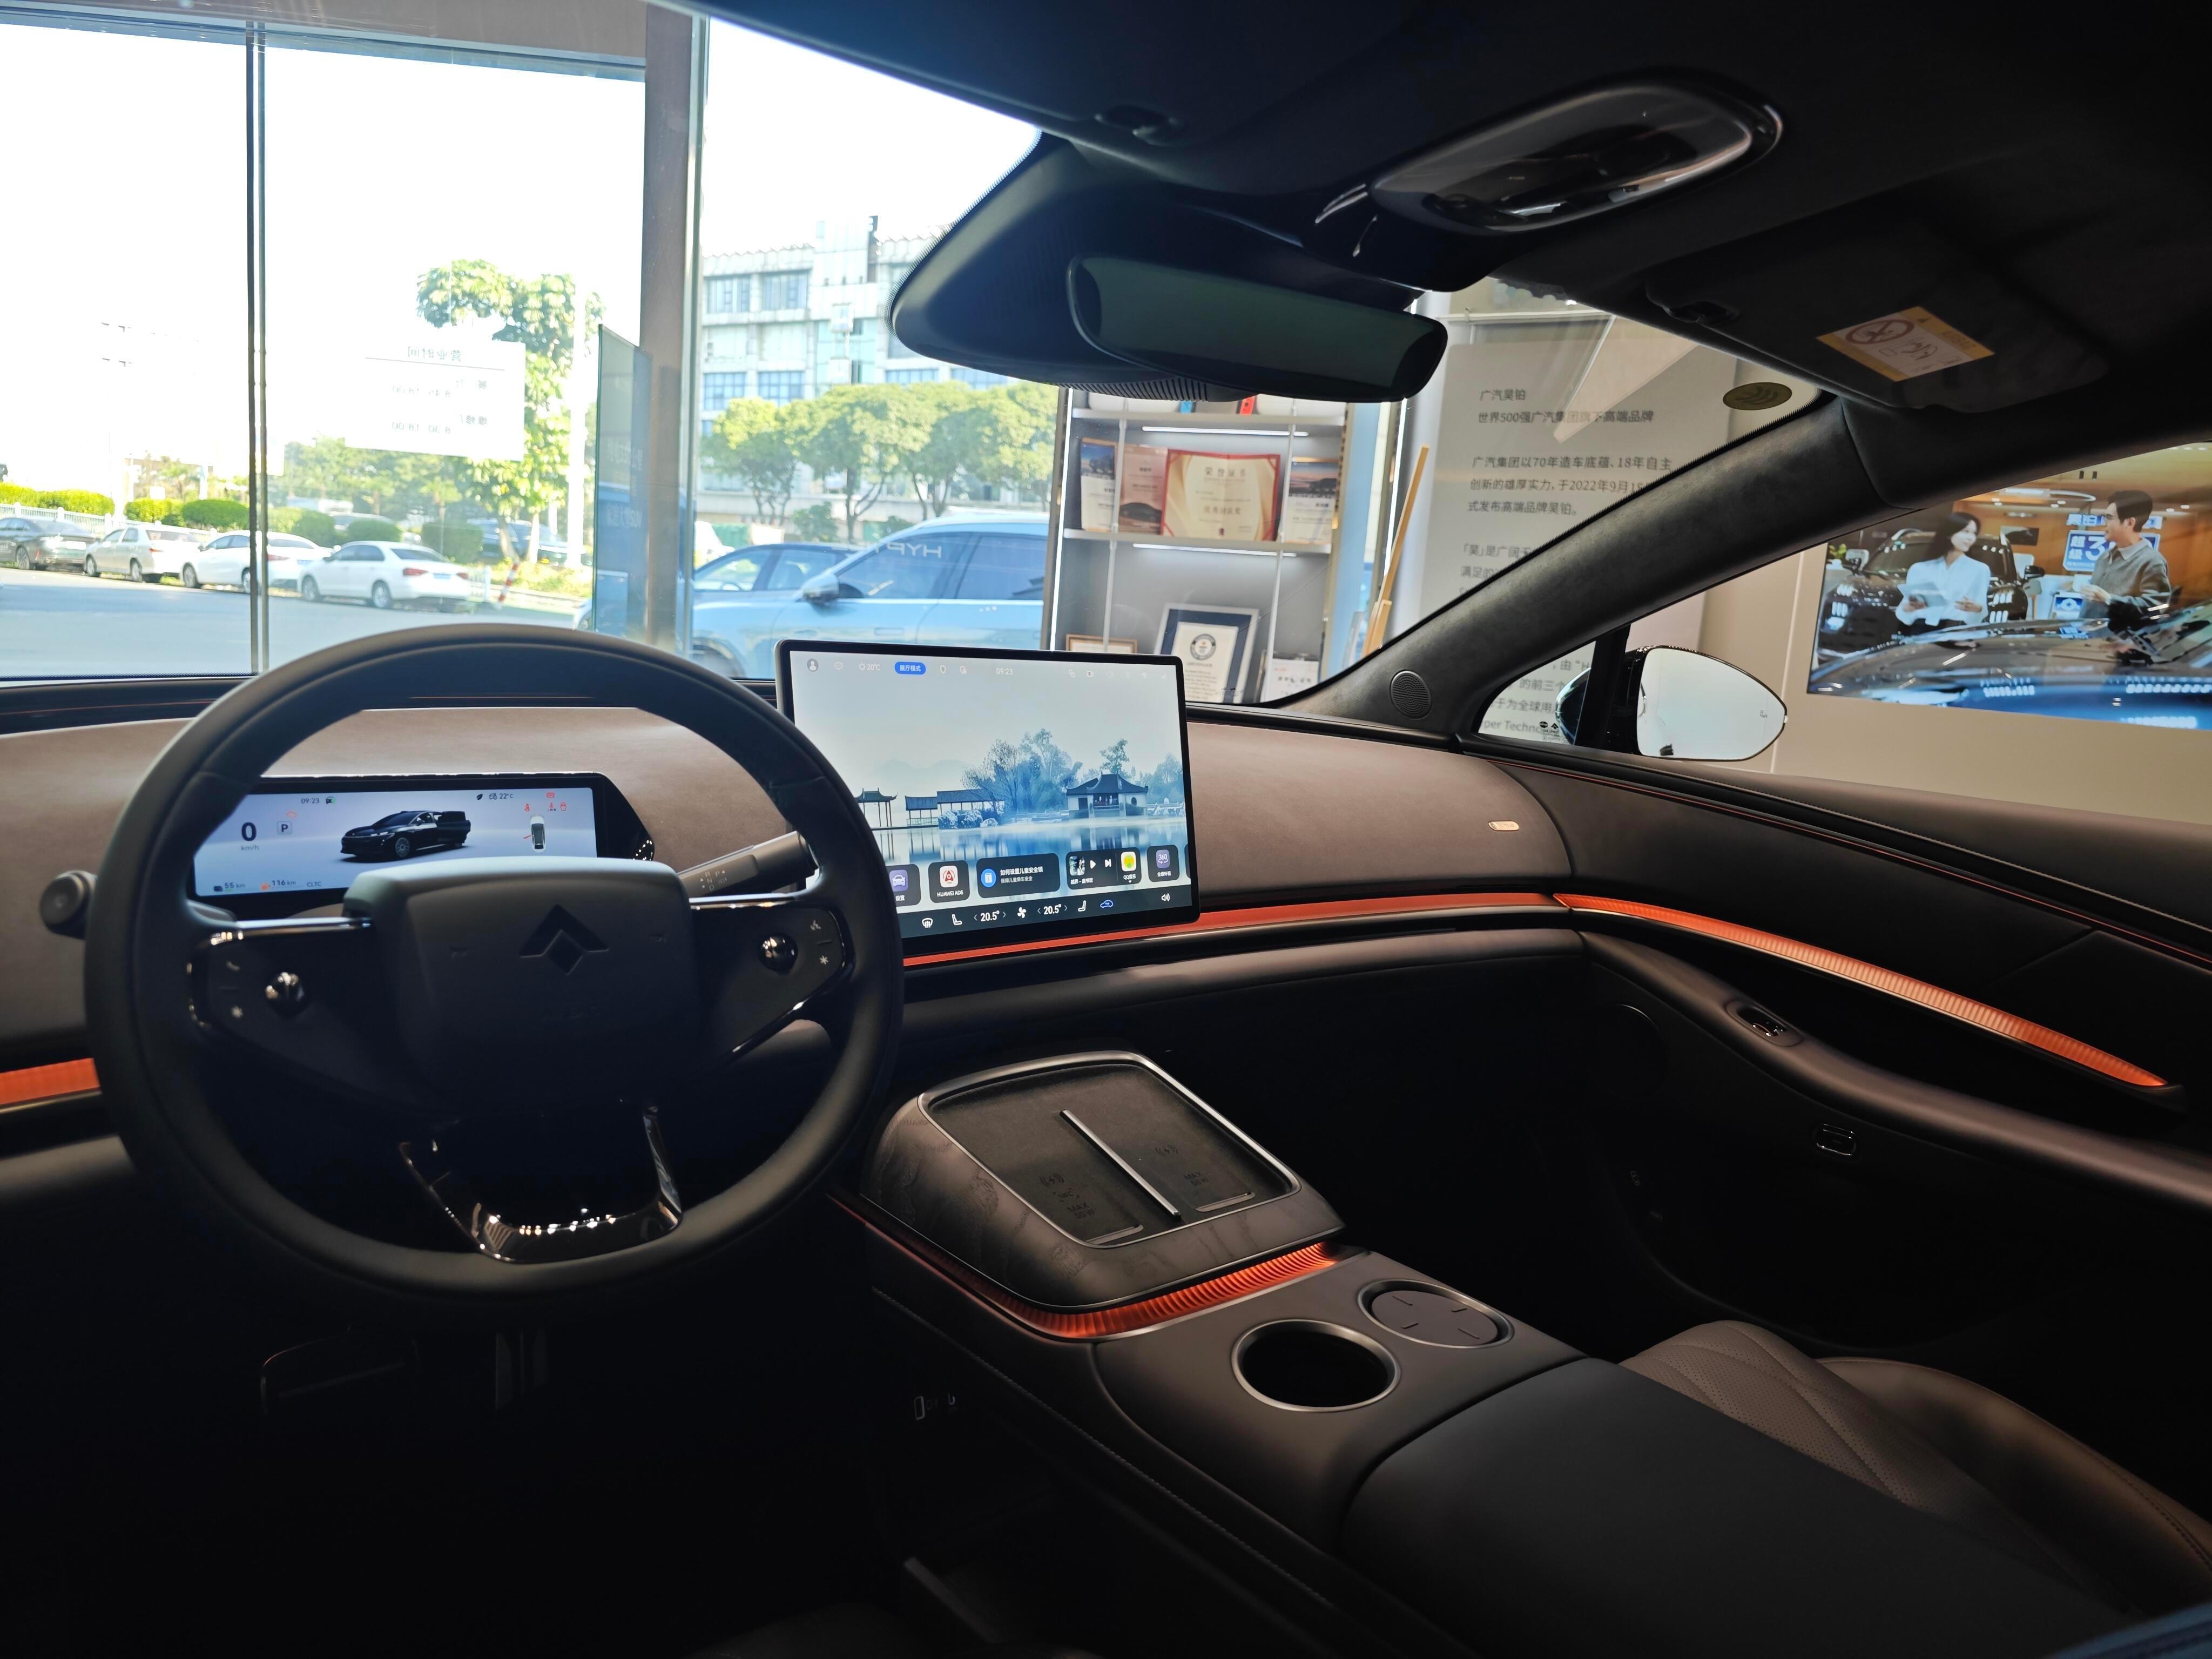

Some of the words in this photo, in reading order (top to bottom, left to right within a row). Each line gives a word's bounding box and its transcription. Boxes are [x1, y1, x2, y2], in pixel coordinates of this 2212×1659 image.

[1479, 389, 1526, 401] 广汽昊铂
[1478, 410, 1654, 423] 世界500强广汽集团旗下高端品牌
[1468, 501, 1577, 515] 式发布高端品牌昊铂。
[900, 664, 921, 673] 展厅模式
[1482, 719, 1502, 730] per
[241, 822, 257, 841] 0
[281, 824, 288, 832] P
[1000, 866, 1043, 876] 如何设置儿童安全锁
